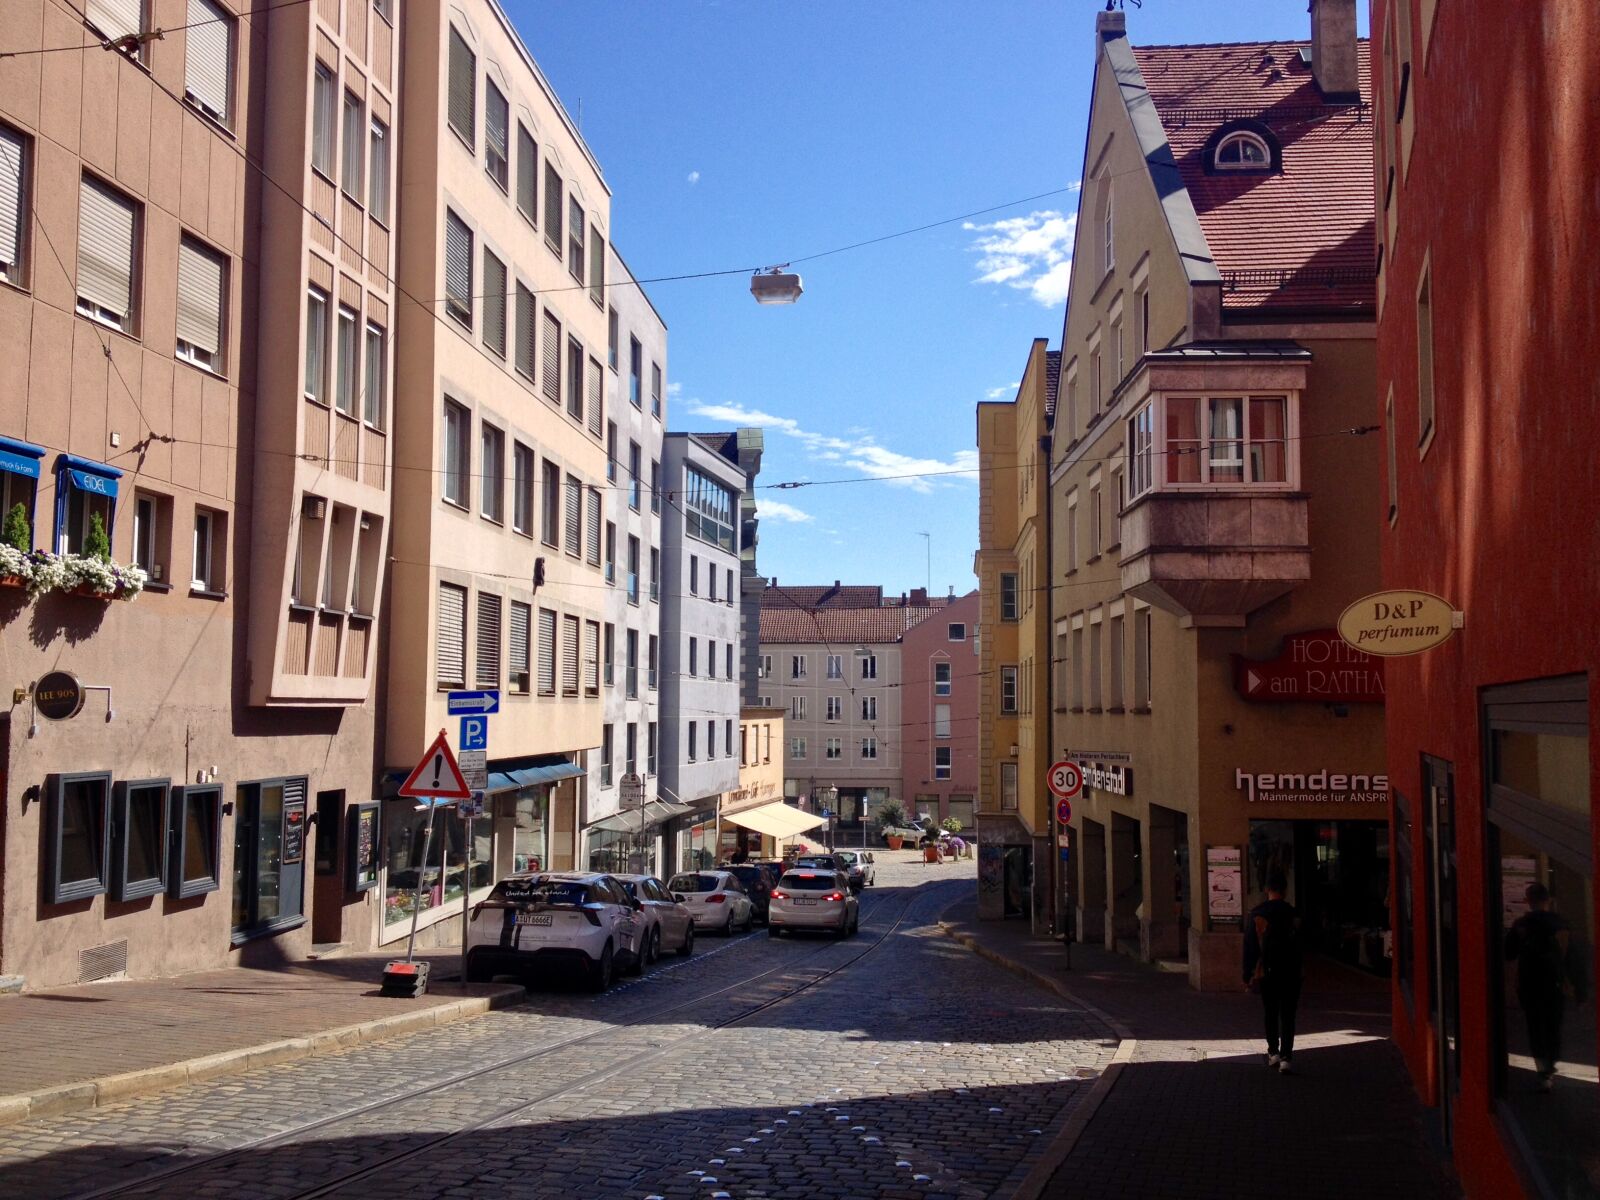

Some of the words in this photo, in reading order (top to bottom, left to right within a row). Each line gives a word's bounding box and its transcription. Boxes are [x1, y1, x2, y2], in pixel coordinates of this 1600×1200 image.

[1374, 600, 1424, 620] D&P
[1356, 625, 1440, 643] perfumum
[1270, 677, 1298, 693] am
[466, 720, 482, 746] P
[1055, 771, 1075, 787] 30
[1079, 761, 1125, 797] emdenstadl
[1235, 768, 1389, 801] hemdens
[1259, 791, 1328, 801] Männermode
[1331, 792, 1346, 801] für
[1350, 792, 1389, 802] ANSPR
